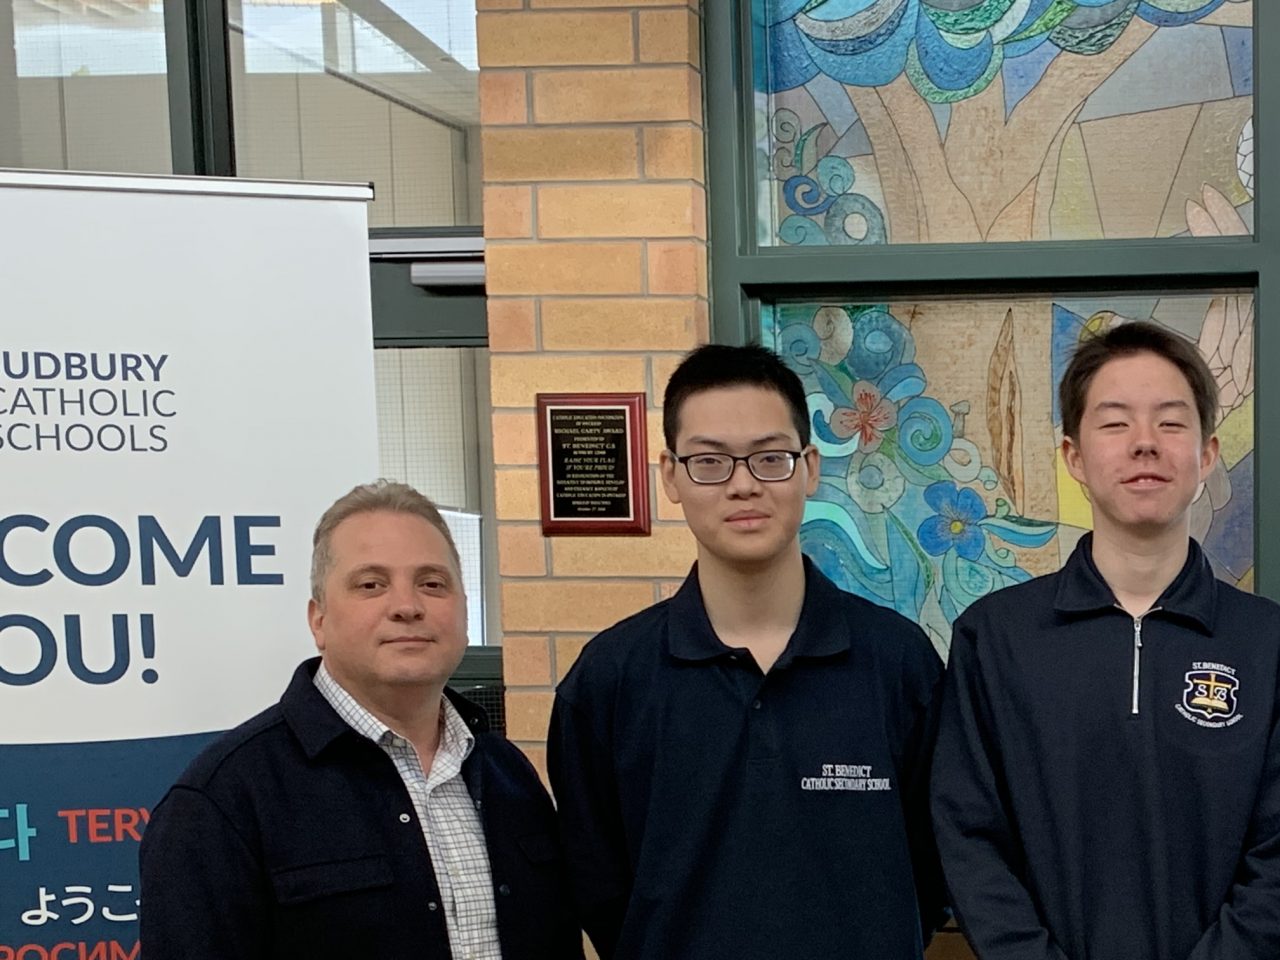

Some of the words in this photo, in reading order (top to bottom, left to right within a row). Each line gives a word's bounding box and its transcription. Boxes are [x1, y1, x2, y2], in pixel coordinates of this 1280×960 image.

[2, 350, 168, 382] UDBURY
[0, 387, 178, 418] ATHOLIC
[0, 423, 168, 452] CHOOLS
[0, 514, 285, 588] COME
[0, 613, 160, 687] OU!
[835, 764, 872, 778] BENEDICT
[21, 884, 140, 926] ようこ
